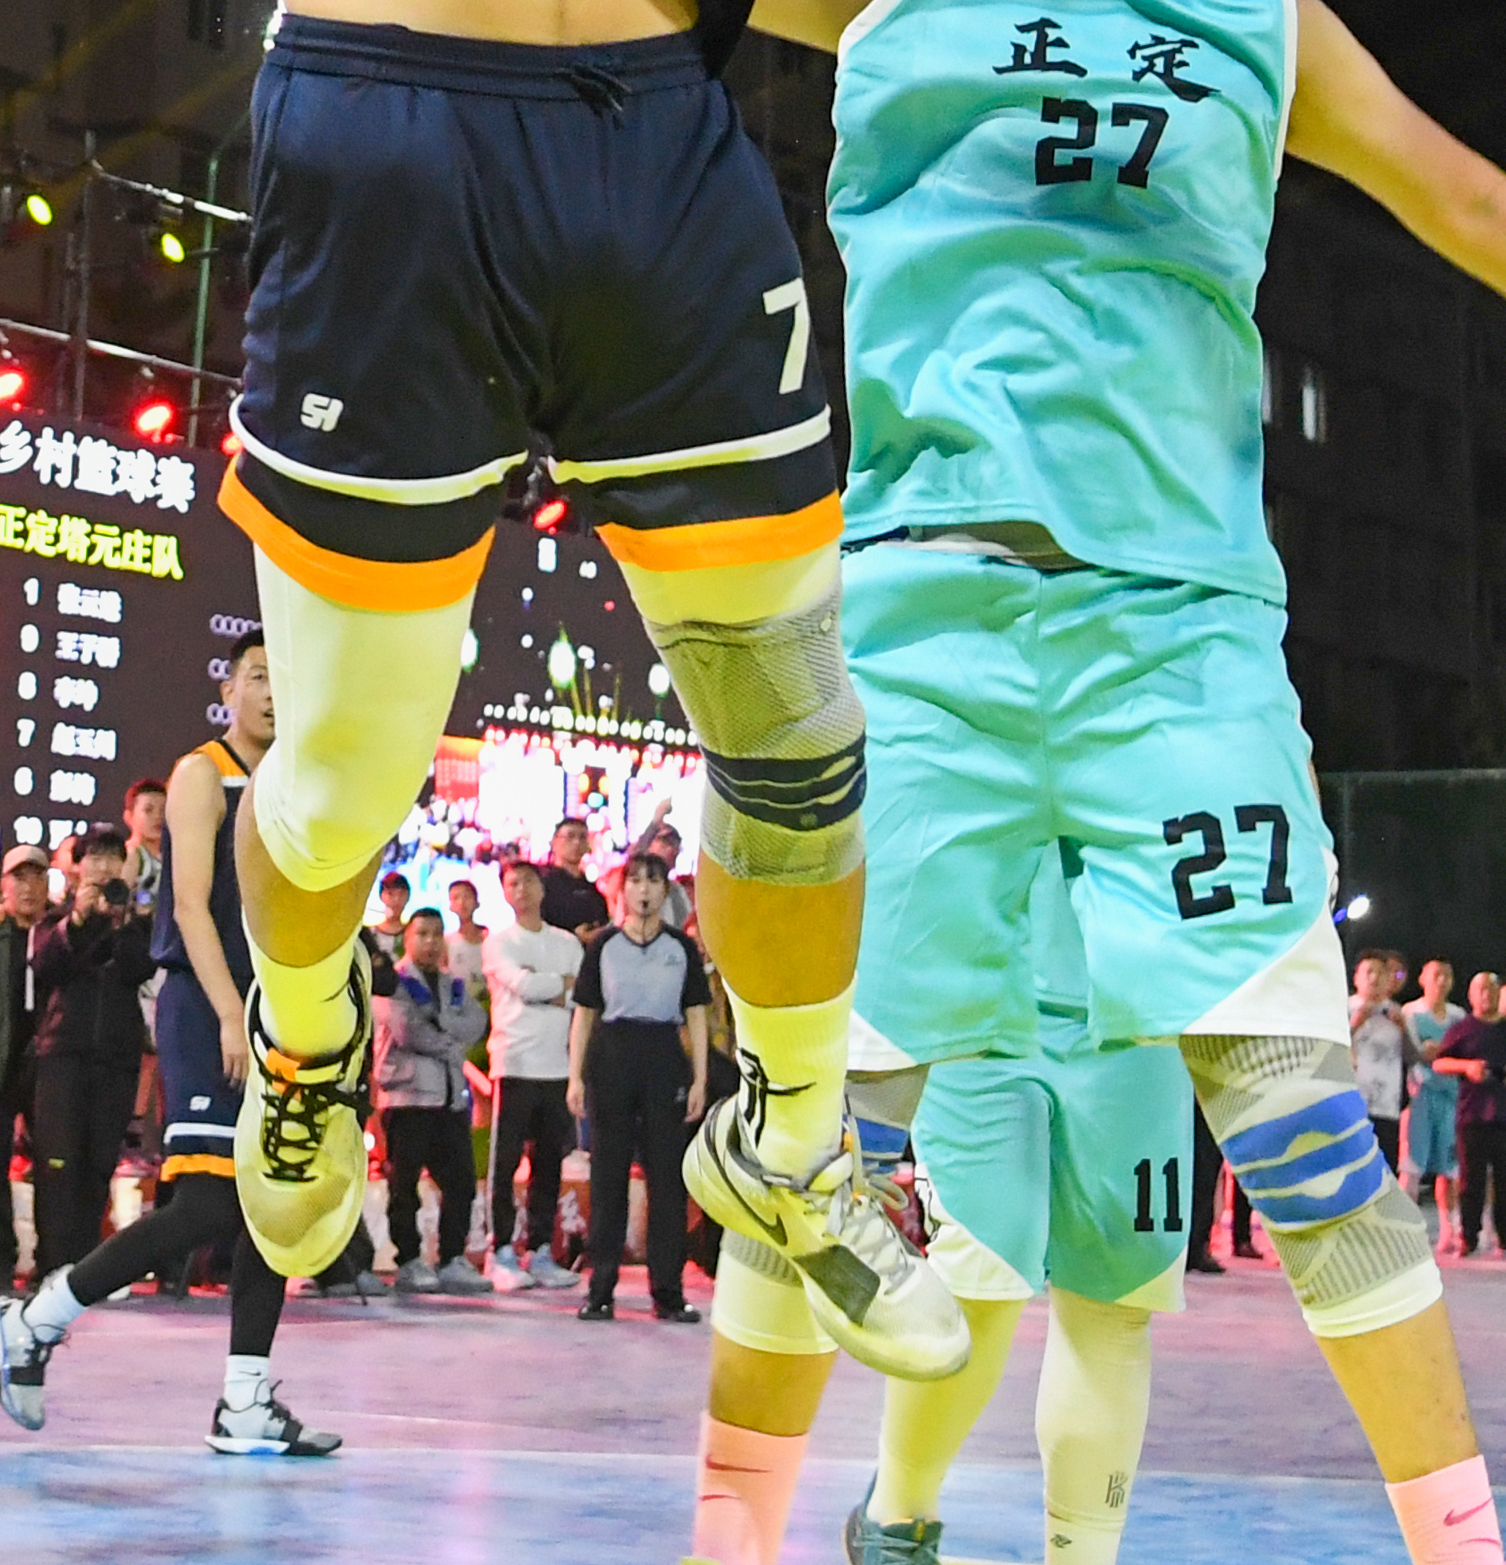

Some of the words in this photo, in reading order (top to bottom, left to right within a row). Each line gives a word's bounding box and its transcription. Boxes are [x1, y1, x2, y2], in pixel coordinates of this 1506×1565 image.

[992, 16, 1222, 103] 正定
[1034, 96, 1170, 190] 27
[762, 277, 811, 395] 7
[23, 577, 40, 606] 1
[16, 718, 36, 748] 7
[1161, 803, 1294, 921] 27
[1133, 1157, 1184, 1234] 11
